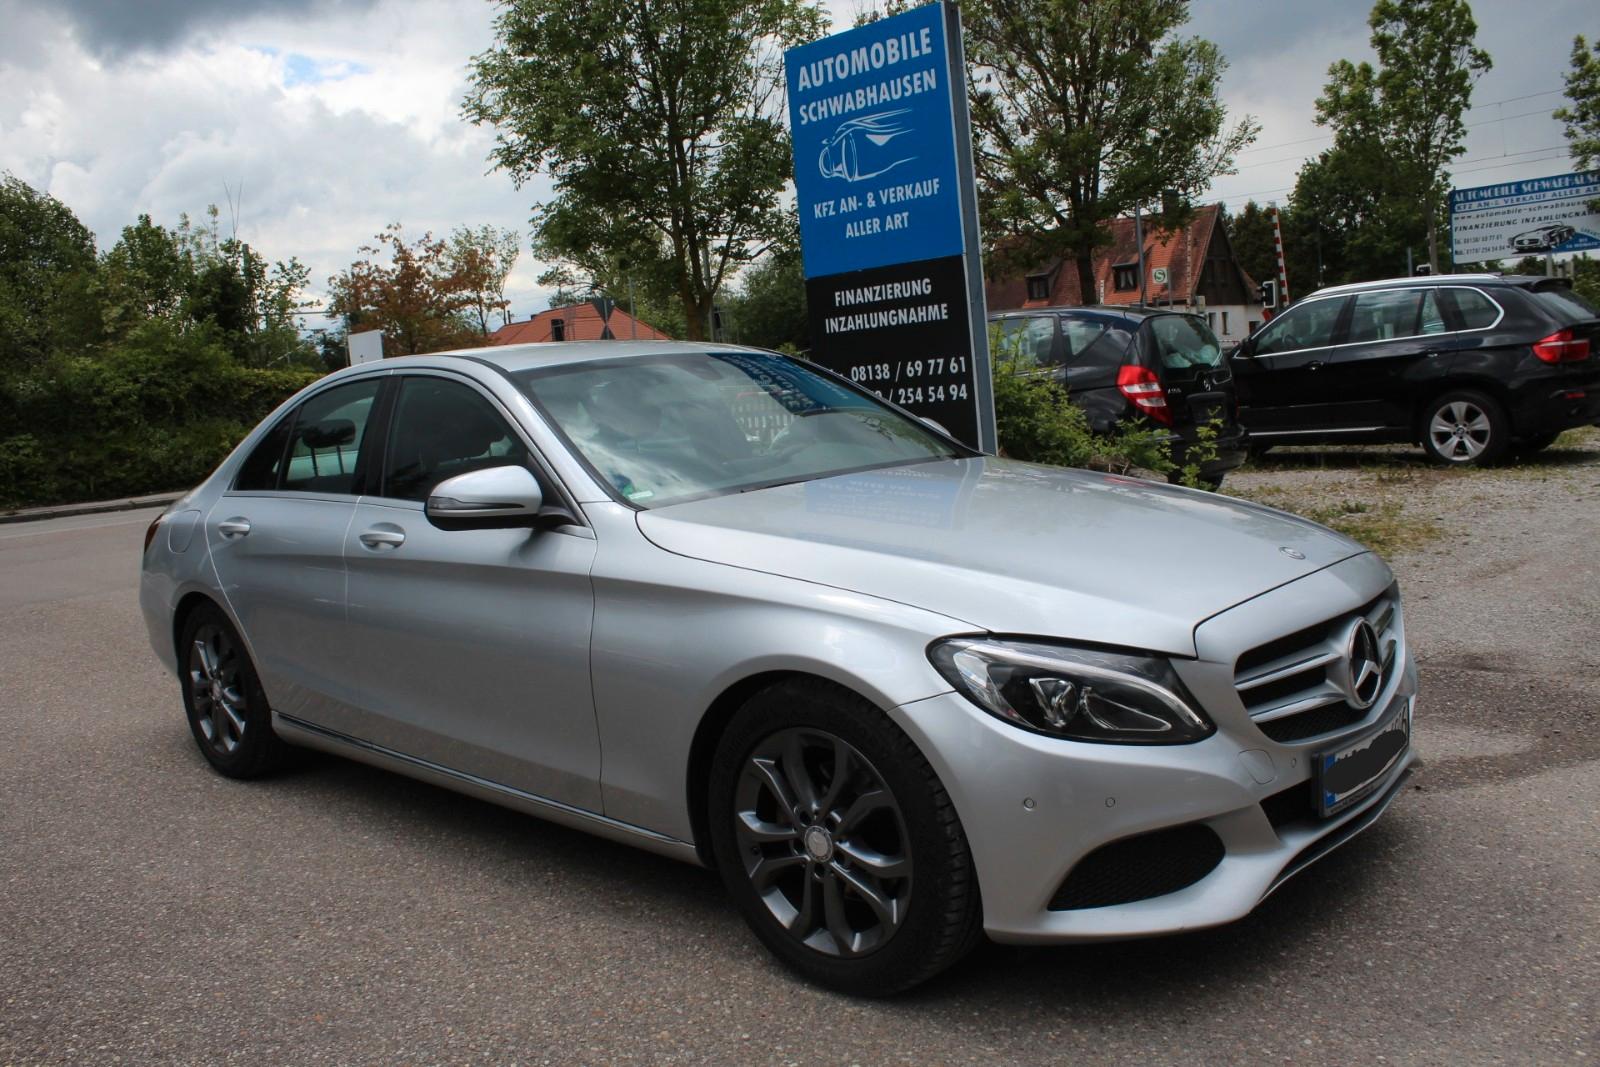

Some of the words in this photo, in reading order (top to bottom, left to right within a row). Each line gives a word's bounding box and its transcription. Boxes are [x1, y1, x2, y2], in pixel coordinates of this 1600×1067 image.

[798, 27, 932, 92] AUTOMOBILE
[799, 68, 937, 125] SCHWABHAUSEN
[814, 200, 836, 219] KFZ
[839, 196, 863, 214] AN-
[866, 191, 876, 208] &
[879, 178, 940, 206] VERKAUF
[1454, 184, 1518, 202] AUTOMOBILE
[1503, 192, 1546, 204] VERKAUF
[845, 216, 881, 239] ALLER
[885, 212, 909, 232] ART
[1454, 218, 1518, 233] FINANZIERUNG
[835, 278, 932, 307] FINANZIERUNG
[825, 303, 949, 334] INZAHLUNGNAHME
[851, 363, 890, 382] 08138
[906, 360, 923, 377] 69
[928, 358, 944, 376] 77
[949, 356, 966, 374] 61
[898, 387, 923, 405] 254
[928, 385, 945, 402] 54
[949, 383, 968, 400] 94
